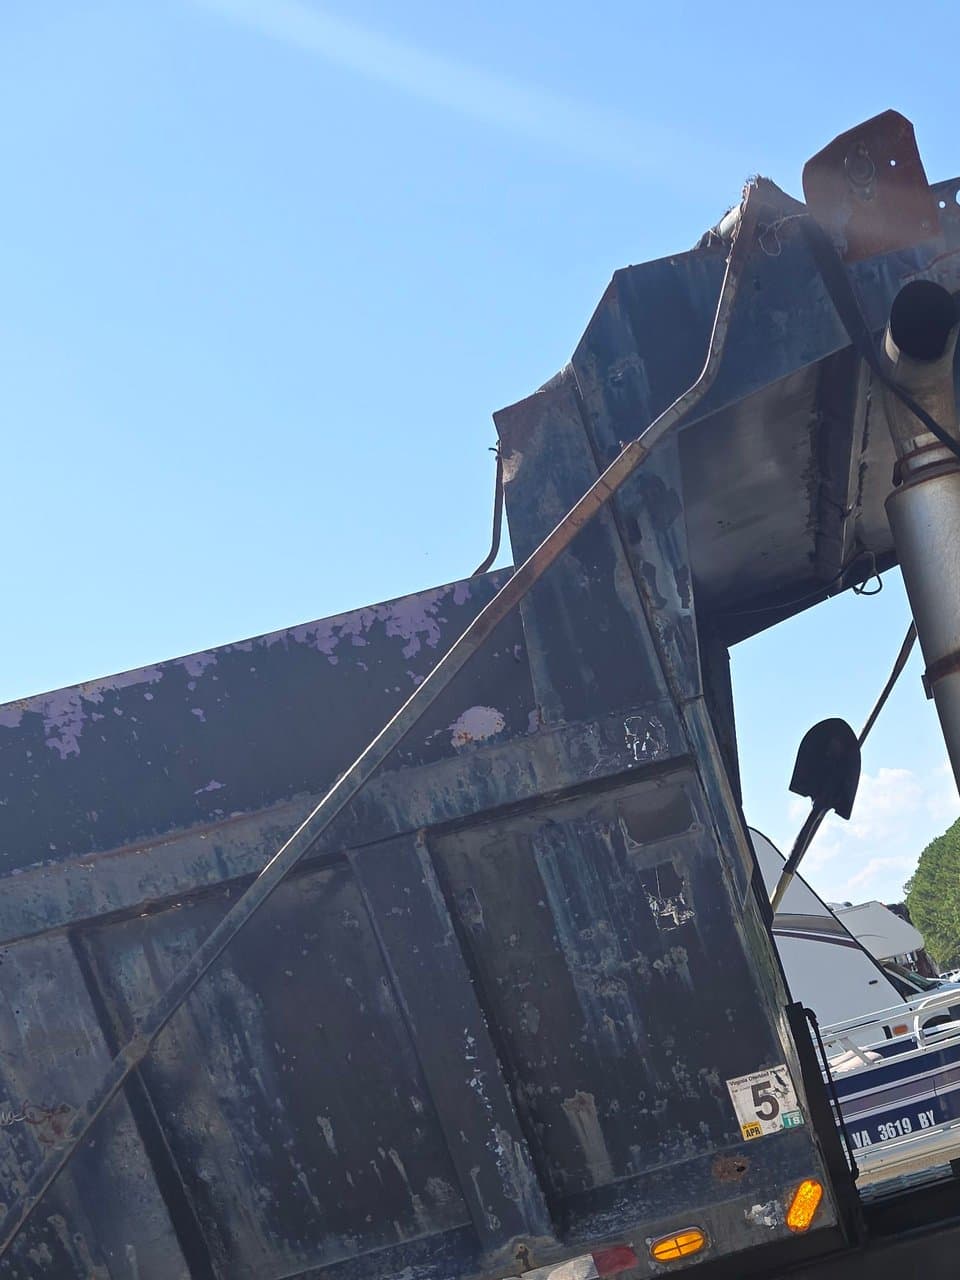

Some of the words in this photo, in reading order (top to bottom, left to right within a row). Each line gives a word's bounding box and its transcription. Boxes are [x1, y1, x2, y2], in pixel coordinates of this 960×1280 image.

[750, 1080, 780, 1121] 5
[745, 1126, 761, 1138] APR
[851, 1129, 872, 1148] VA
[877, 1117, 913, 1141] 3619
[917, 1109, 935, 1129] BY
